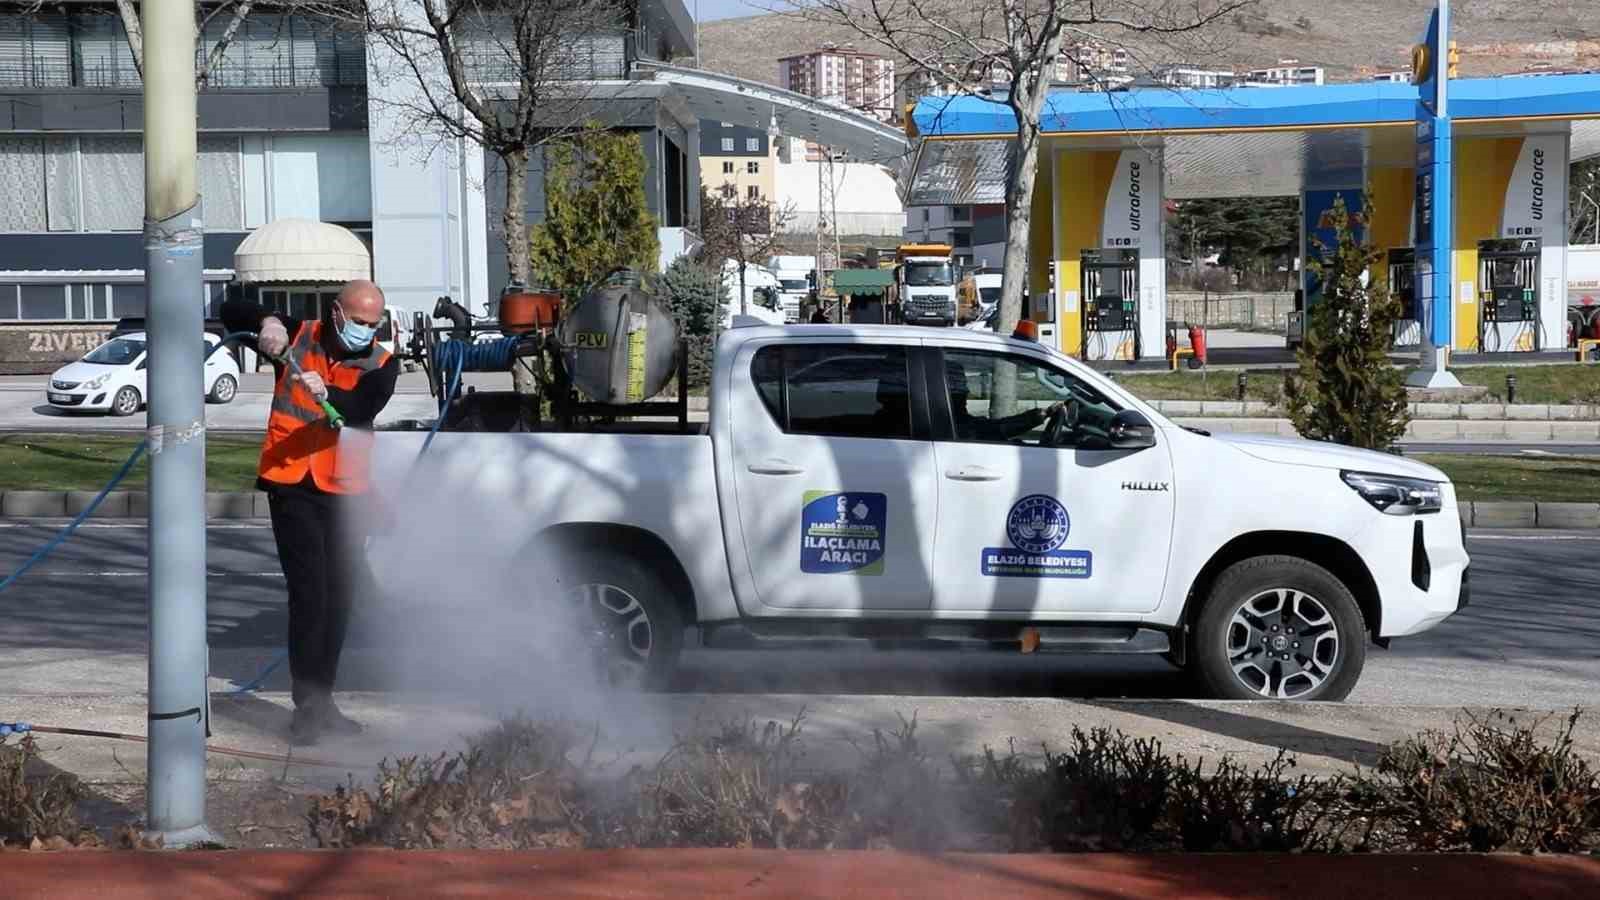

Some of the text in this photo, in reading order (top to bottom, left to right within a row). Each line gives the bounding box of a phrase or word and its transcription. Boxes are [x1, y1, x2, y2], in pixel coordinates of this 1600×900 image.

[1532, 148, 1544, 220] ultraforce
[1130, 162, 1141, 231] ultraforce
[1121, 481, 1168, 492] HILUX
[804, 535, 880, 550] İLAÇLAMA
[820, 550, 867, 563] ARACI
[987, 555, 1087, 567] ELAZIĞ BELEDİYESİ
